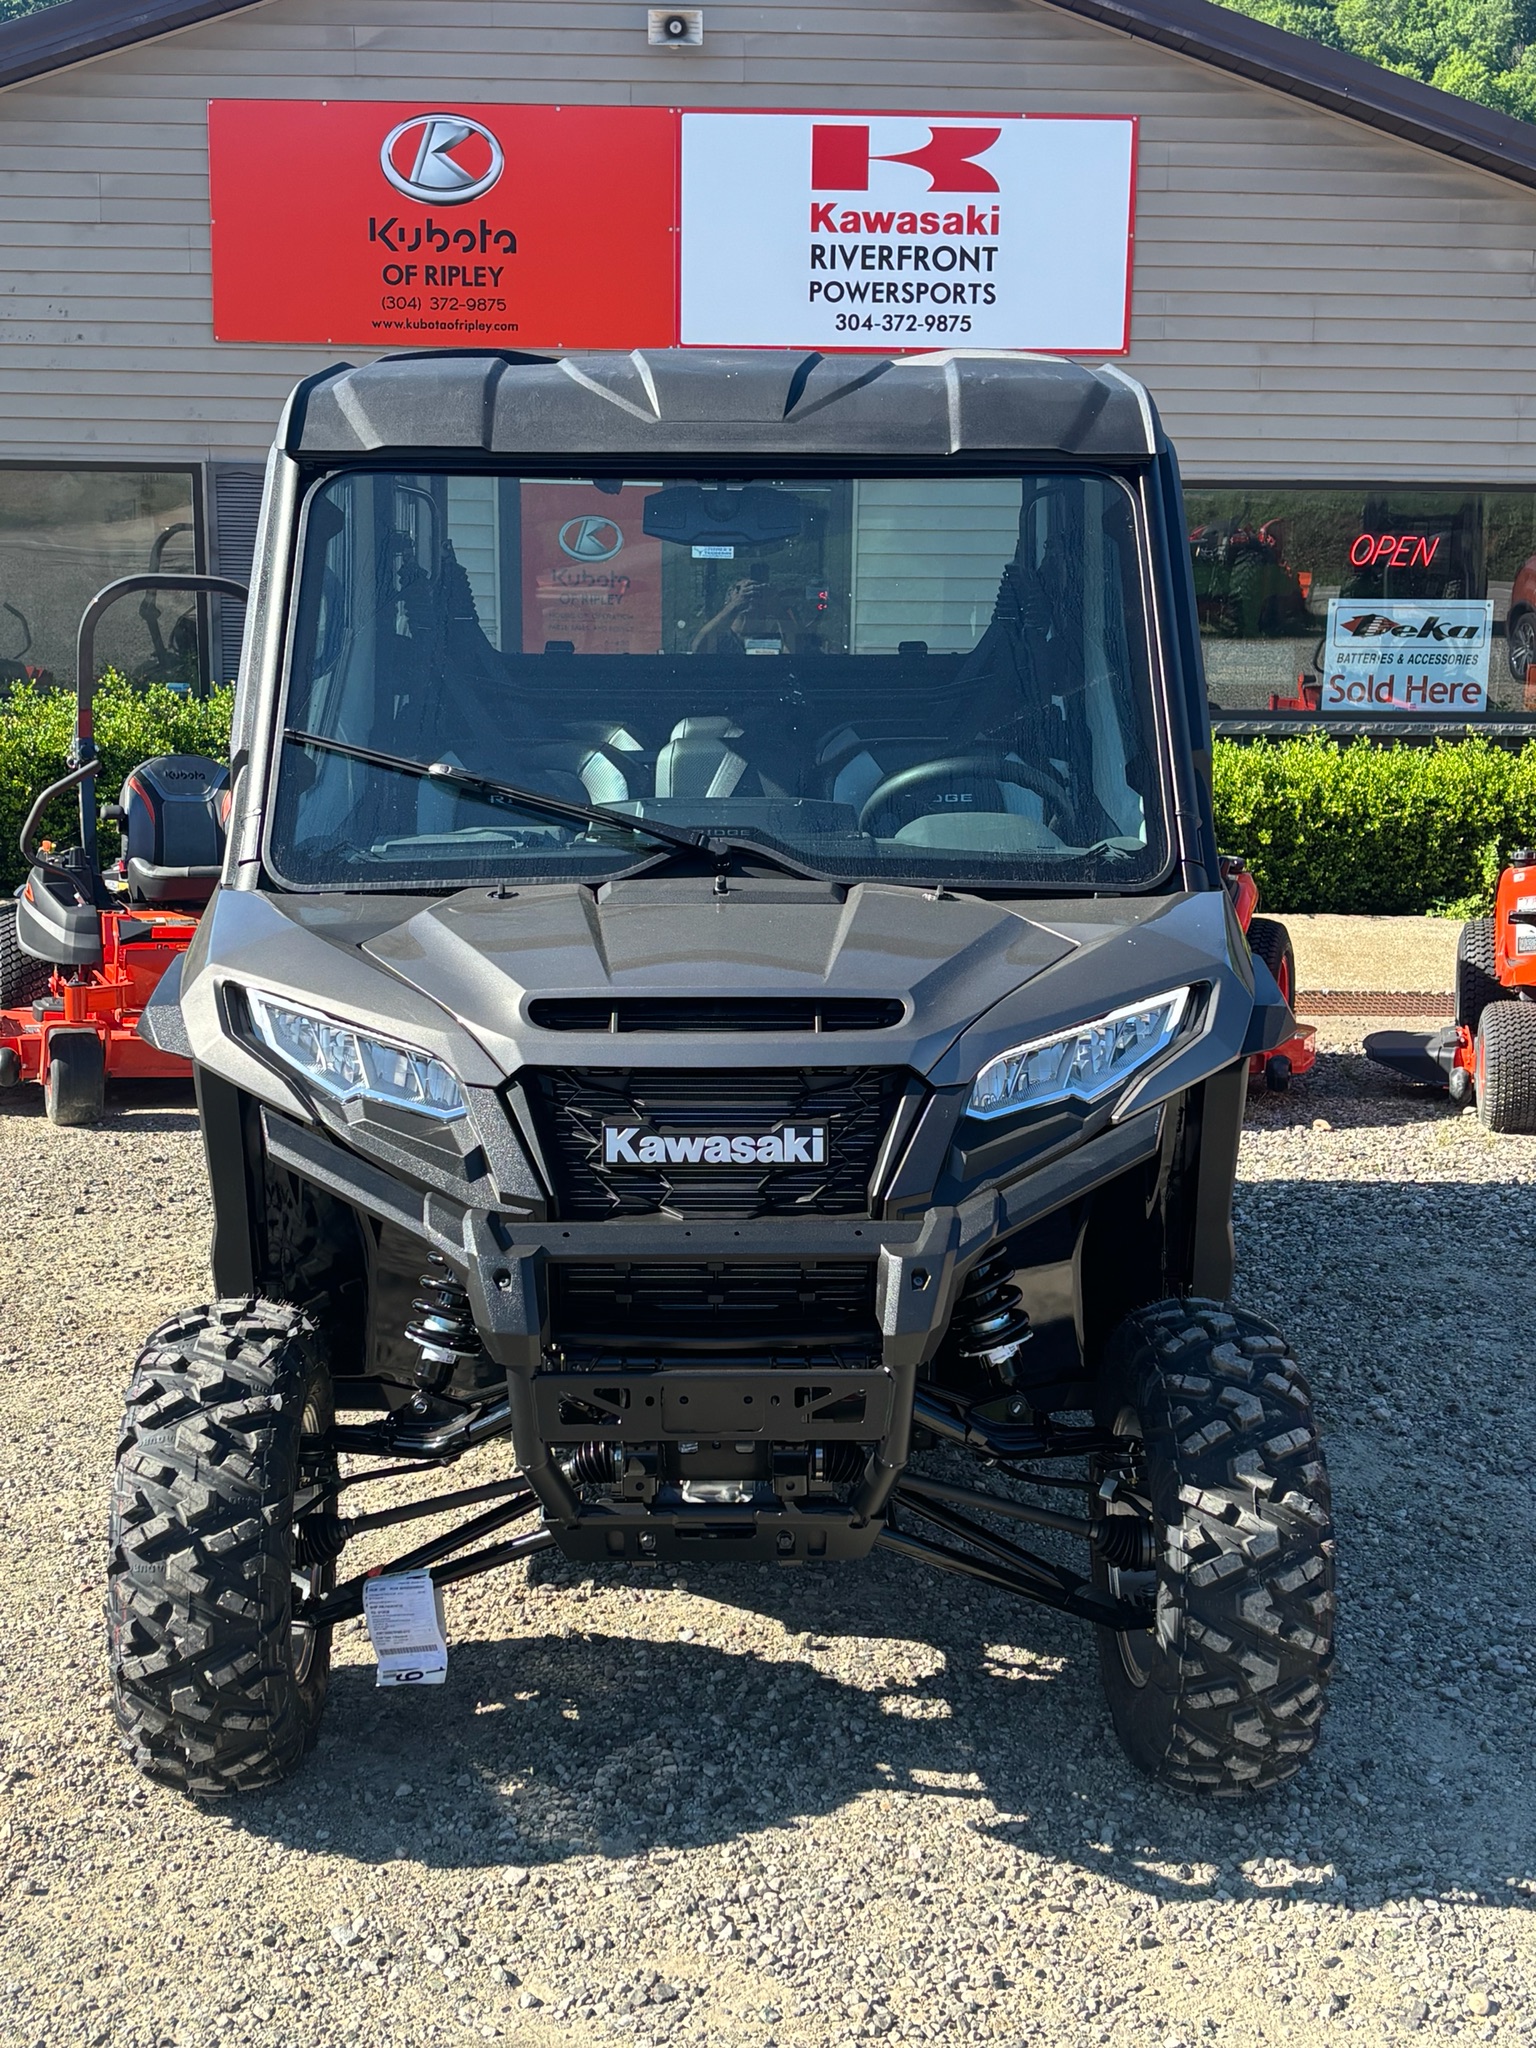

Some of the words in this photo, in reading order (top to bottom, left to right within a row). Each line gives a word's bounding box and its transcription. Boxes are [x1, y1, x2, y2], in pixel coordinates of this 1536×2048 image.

[810, 203, 1000, 236] Kawasaki
[368, 217, 517, 254] Kubota
[810, 244, 999, 273] RIVERFRONT
[382, 264, 418, 286] OF
[424, 265, 504, 287] RIPLEY
[381, 296, 422, 311] (304)
[429, 297, 507, 312] 372-9875
[809, 281, 996, 305] POWERSPORTS
[371, 318, 519, 334] www.kubotaofripley.com
[835, 313, 972, 332] 304-372-9875
[1349, 533, 1440, 568] OPEN
[552, 569, 631, 588] Kubota
[1340, 613, 1480, 641] Deka
[1337, 653, 1394, 665] BATTERIES
[1397, 654, 1404, 664] &
[1407, 653, 1479, 665] ACCESSORIES
[1328, 673, 1395, 704] Sold
[1405, 675, 1482, 704] Here
[164, 770, 206, 780] Kubota
[605, 1127, 824, 1164] Kawasaki
